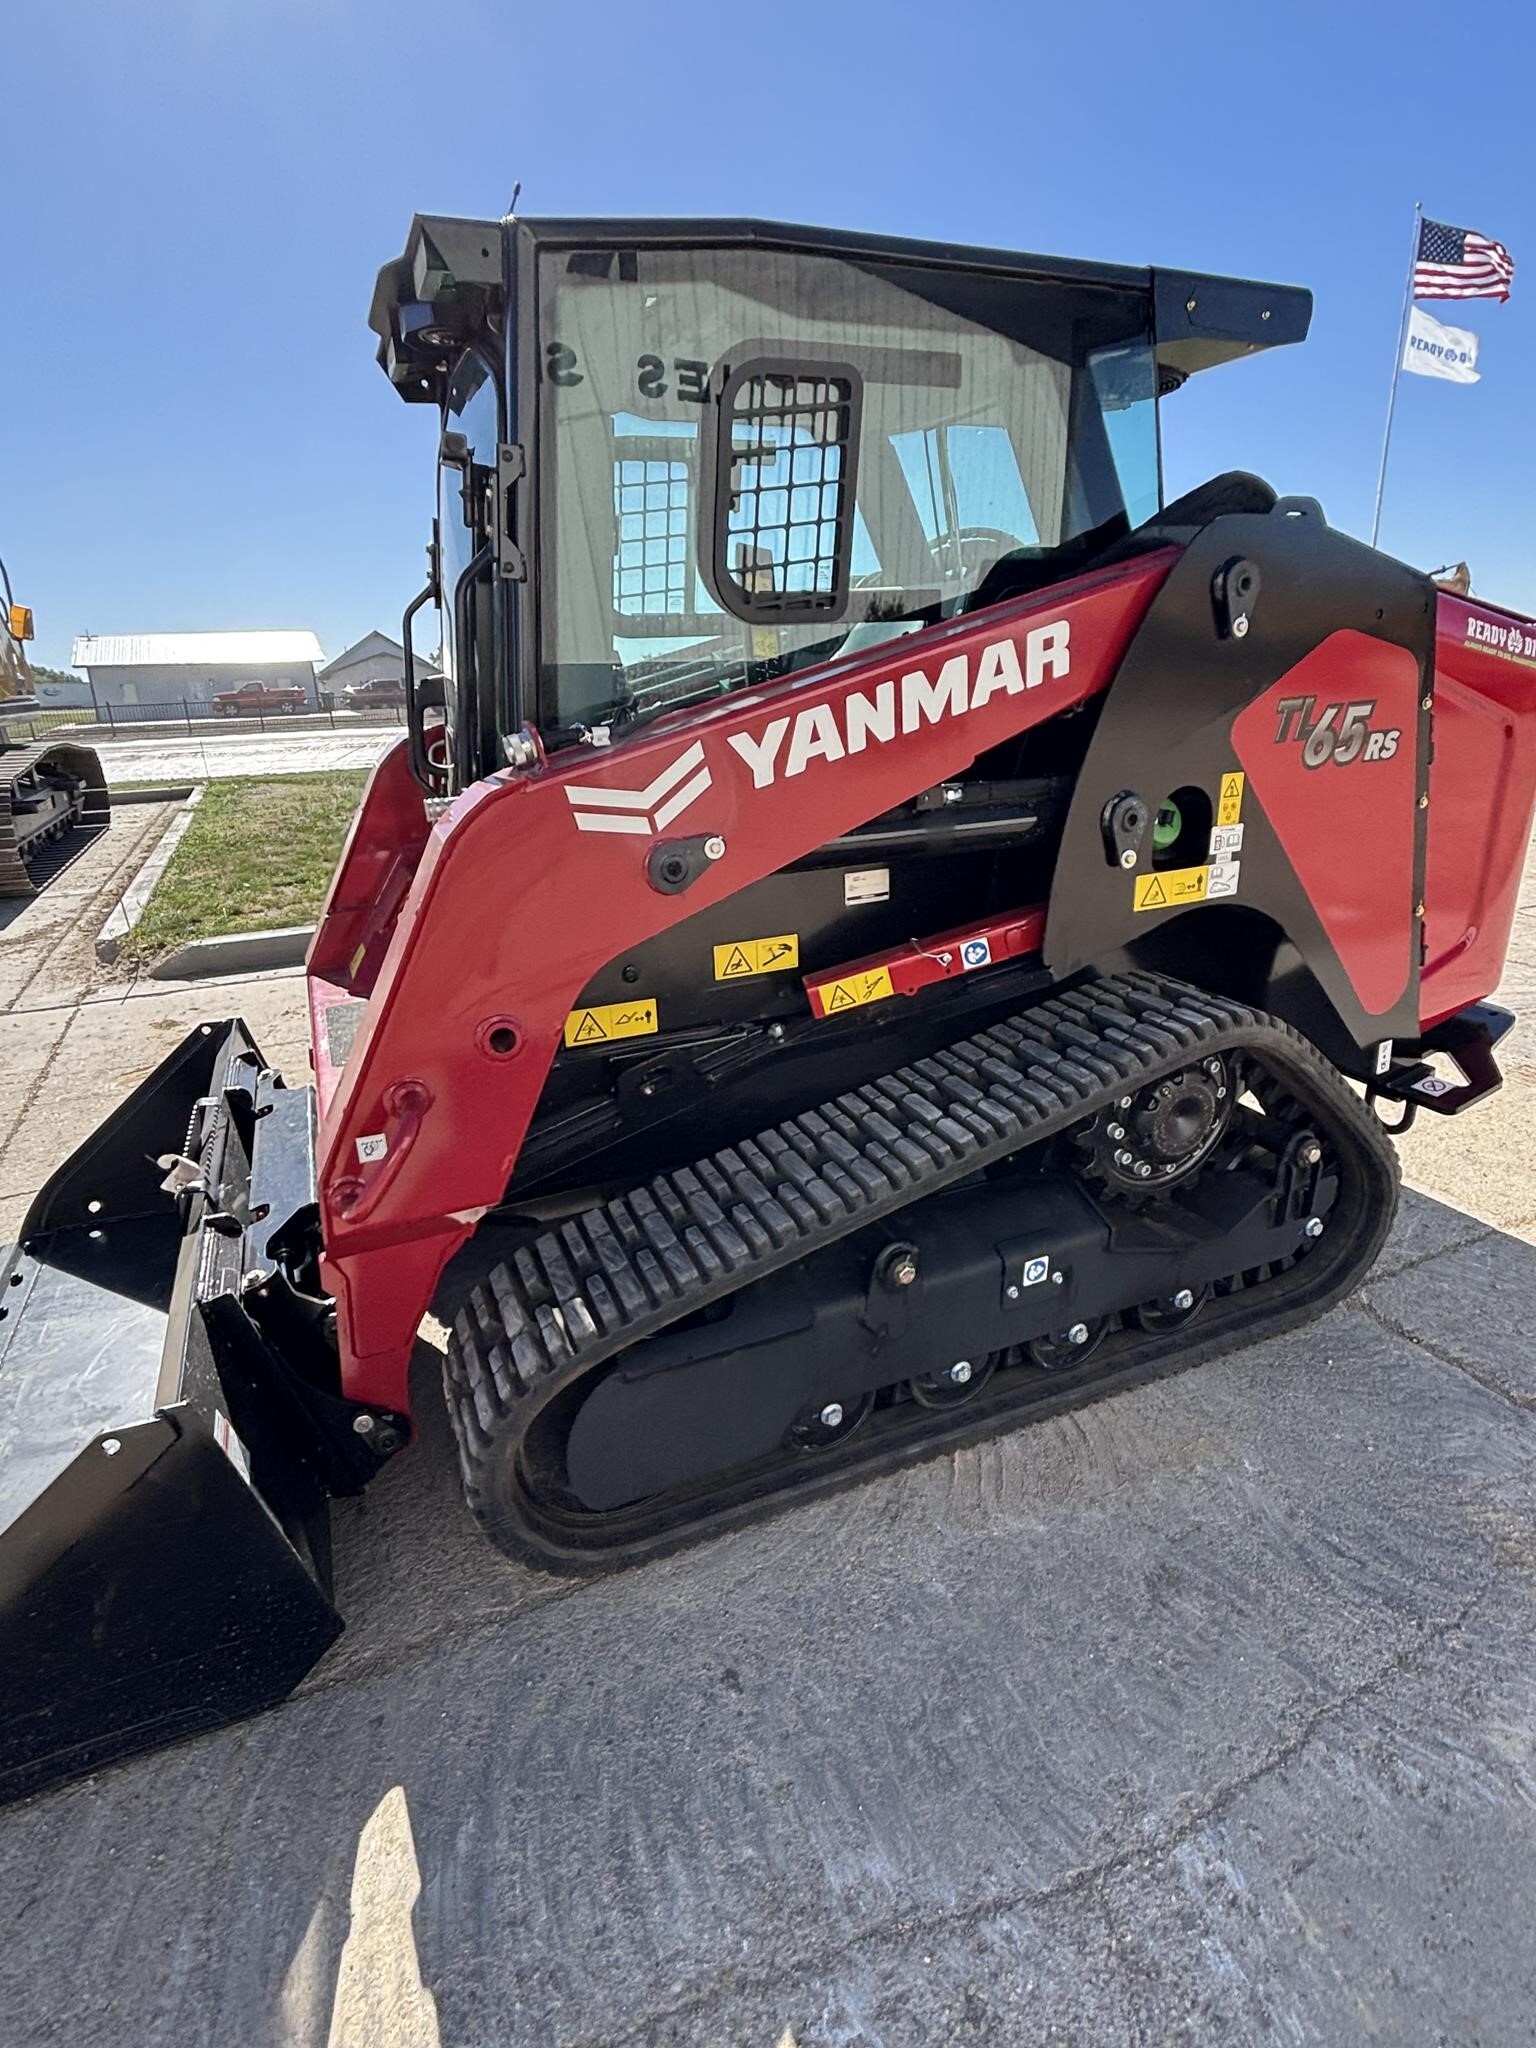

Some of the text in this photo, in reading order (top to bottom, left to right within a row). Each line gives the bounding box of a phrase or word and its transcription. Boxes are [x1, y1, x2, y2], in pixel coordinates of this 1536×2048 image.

[1410, 335, 1443, 359] READY
[1466, 616, 1508, 648] READY
[726, 618, 1071, 790] YANMAR
